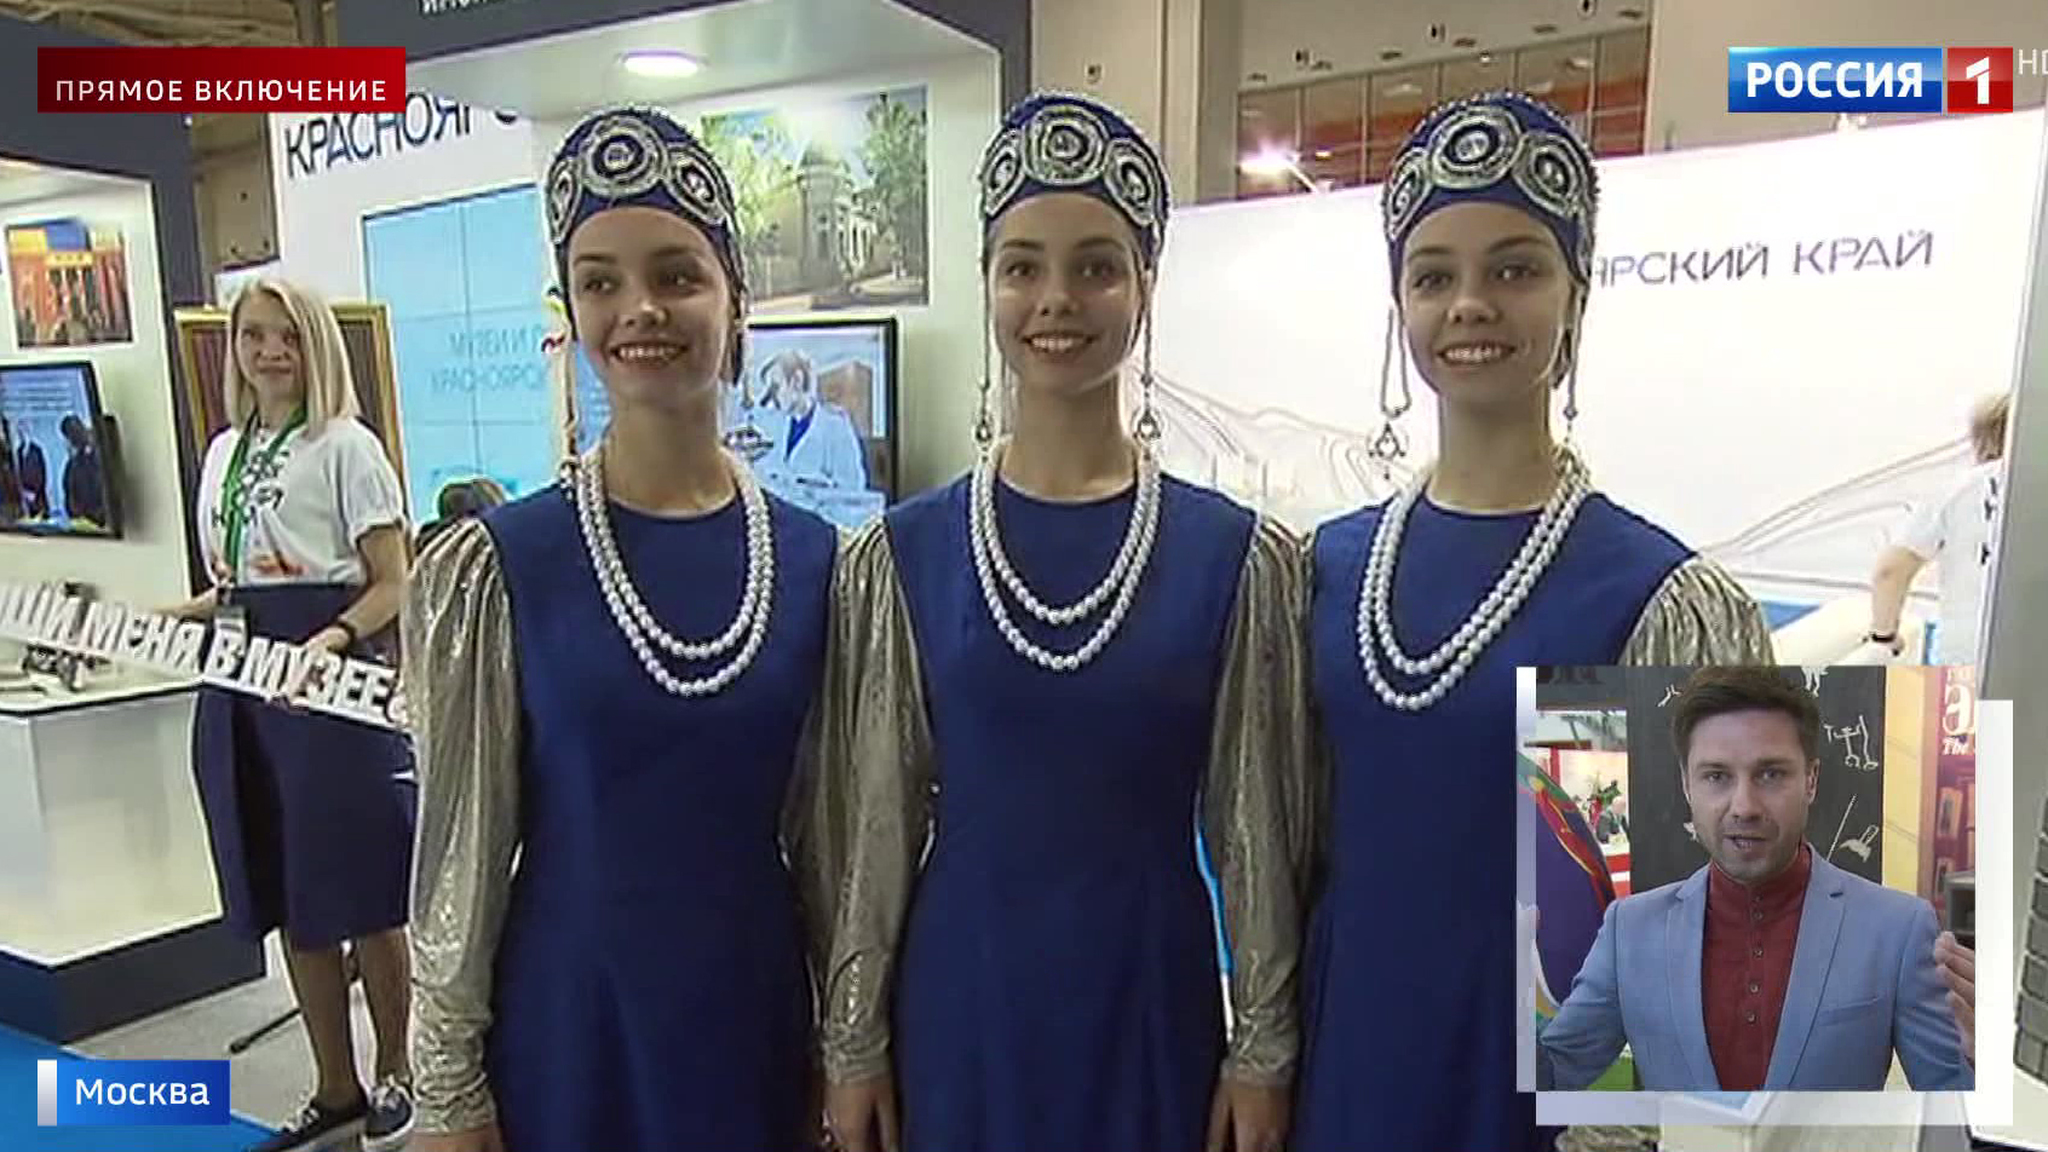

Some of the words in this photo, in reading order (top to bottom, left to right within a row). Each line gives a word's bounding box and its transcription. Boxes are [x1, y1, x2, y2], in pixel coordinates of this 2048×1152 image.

[285, 91, 518, 179] КРАСНОЯ
[1793, 229, 1934, 276] КРАЙ
[76, 602, 206, 674] МЕНЯ
[204, 625, 244, 678] В
